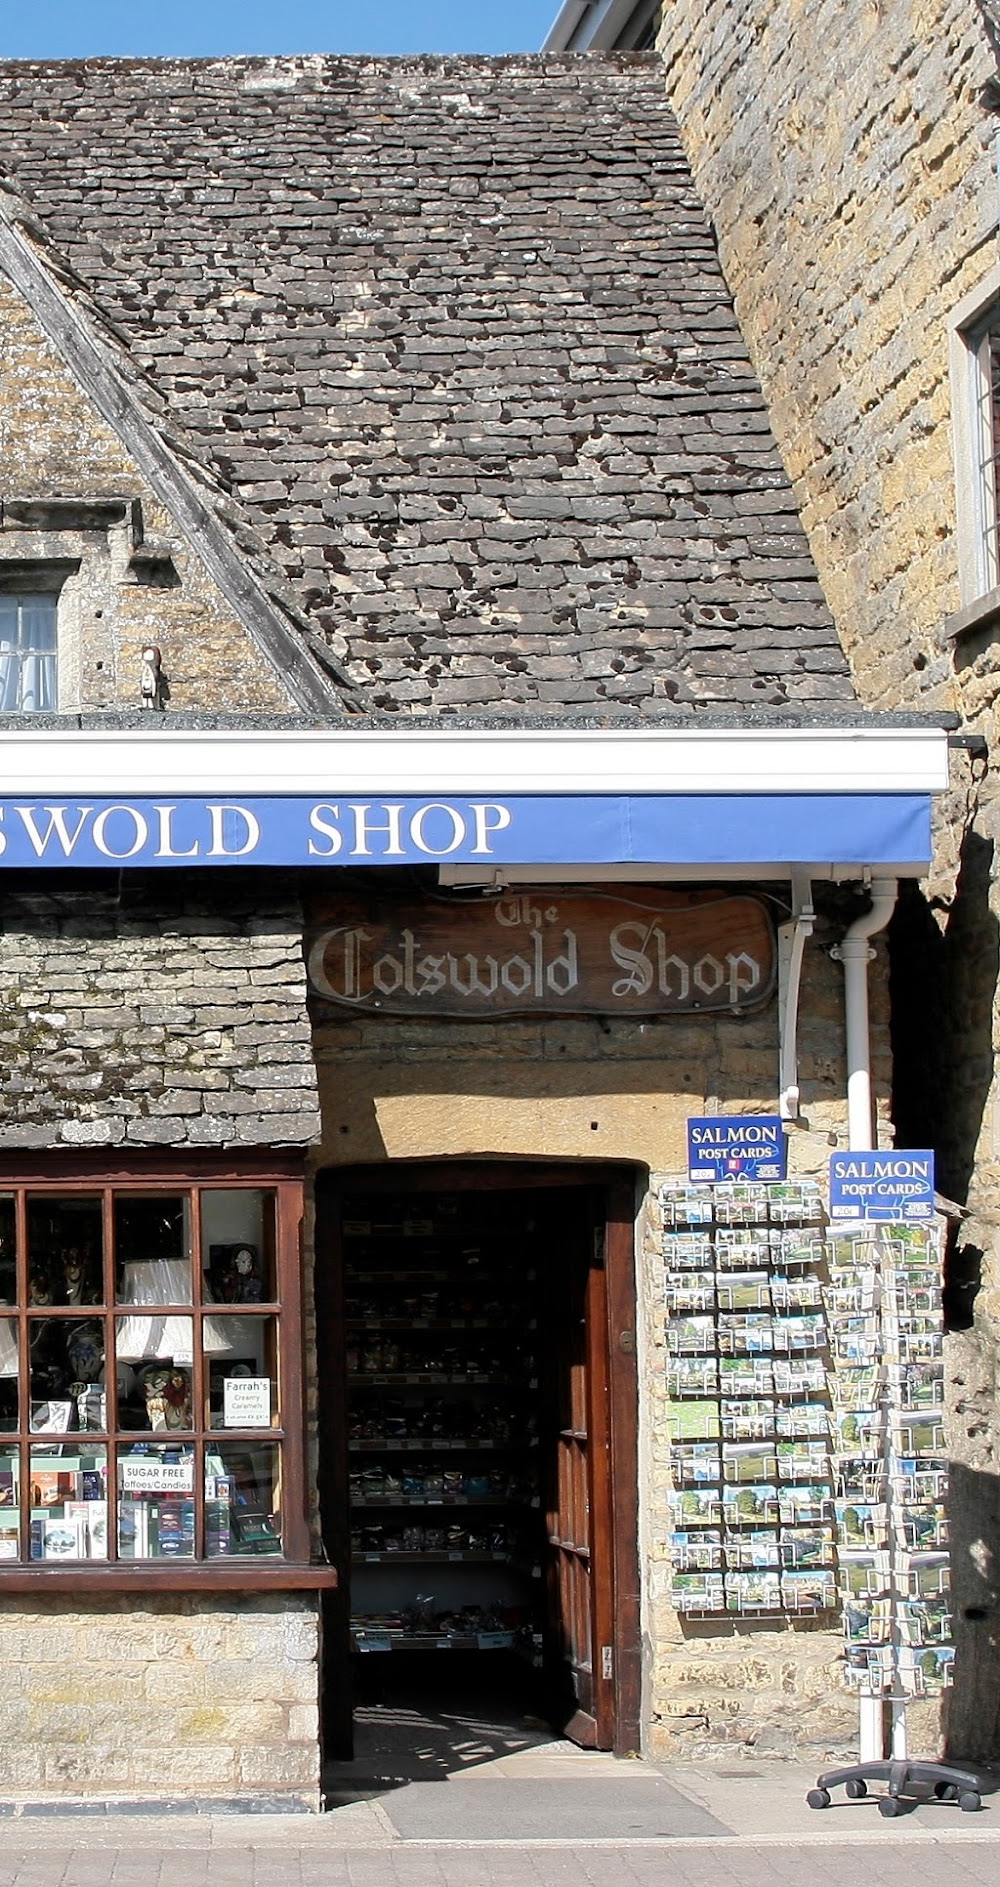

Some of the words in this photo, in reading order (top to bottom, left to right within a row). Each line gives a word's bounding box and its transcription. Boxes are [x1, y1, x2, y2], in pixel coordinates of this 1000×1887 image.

[307, 802, 512, 856] SHOP
[495, 899, 560, 928] The
[309, 926, 579, 1001] Cotswold
[609, 918, 760, 1014] Shop
[691, 1126, 777, 1144] SALMON
[698, 1148, 730, 1160] POST
[731, 1147, 773, 1159] CARDS
[834, 1161, 929, 1179] SALMON
[841, 1185, 877, 1196] POST
[878, 1183, 923, 1195] CARDS
[226, 1381, 268, 1391] Farrah's
[233, 1394, 260, 1402] Creamy
[127, 1468, 160, 1478] SUGAR
[162, 1469, 185, 1478] FREE
